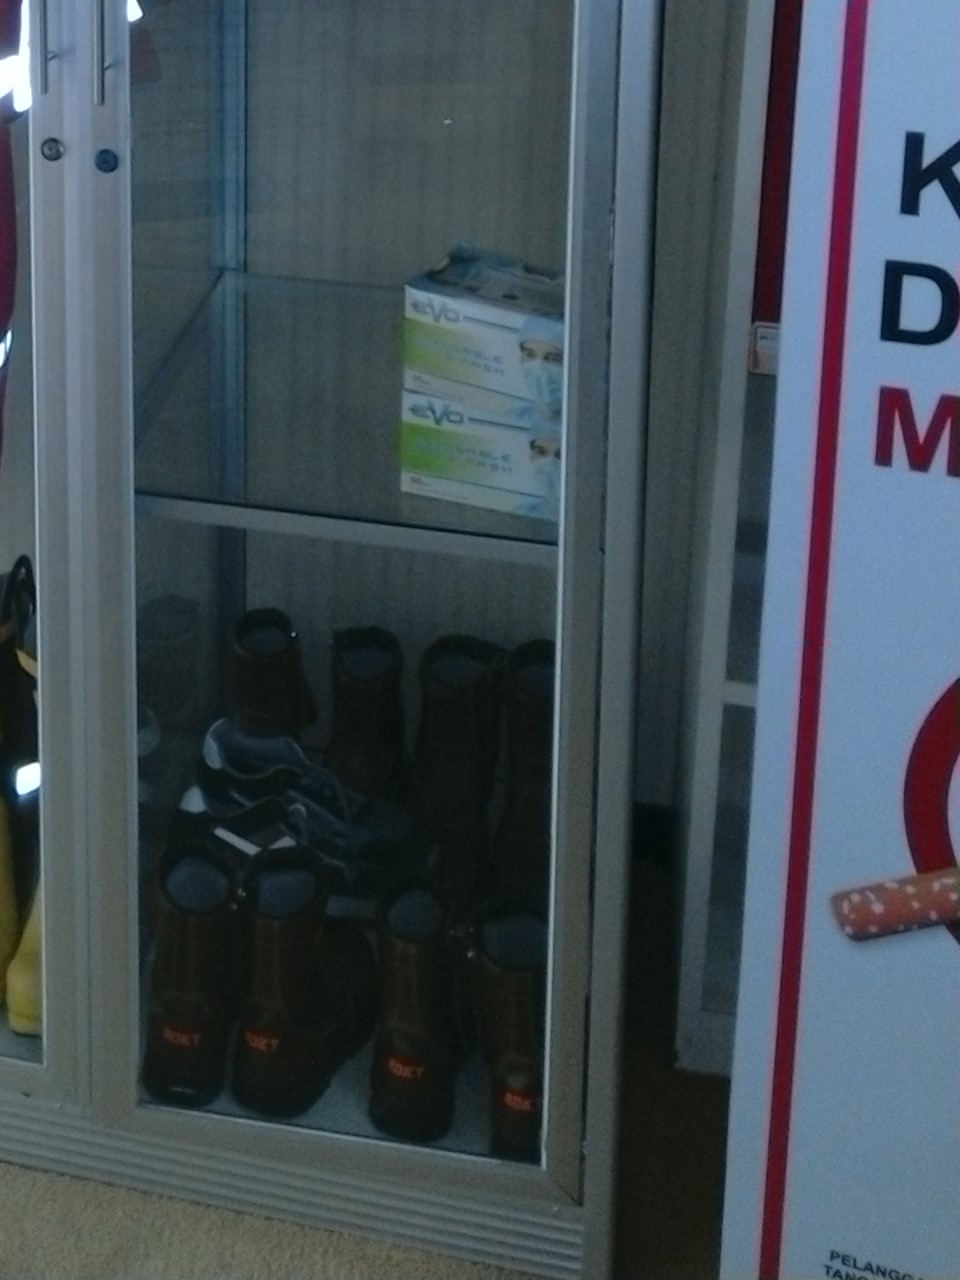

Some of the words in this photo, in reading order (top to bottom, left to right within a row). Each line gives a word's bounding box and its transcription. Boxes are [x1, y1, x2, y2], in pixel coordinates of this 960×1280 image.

[900, 131, 960, 219] K
[880, 260, 960, 346] D
[875, 385, 960, 479] M
[829, 1248, 924, 1280] PELANGG
